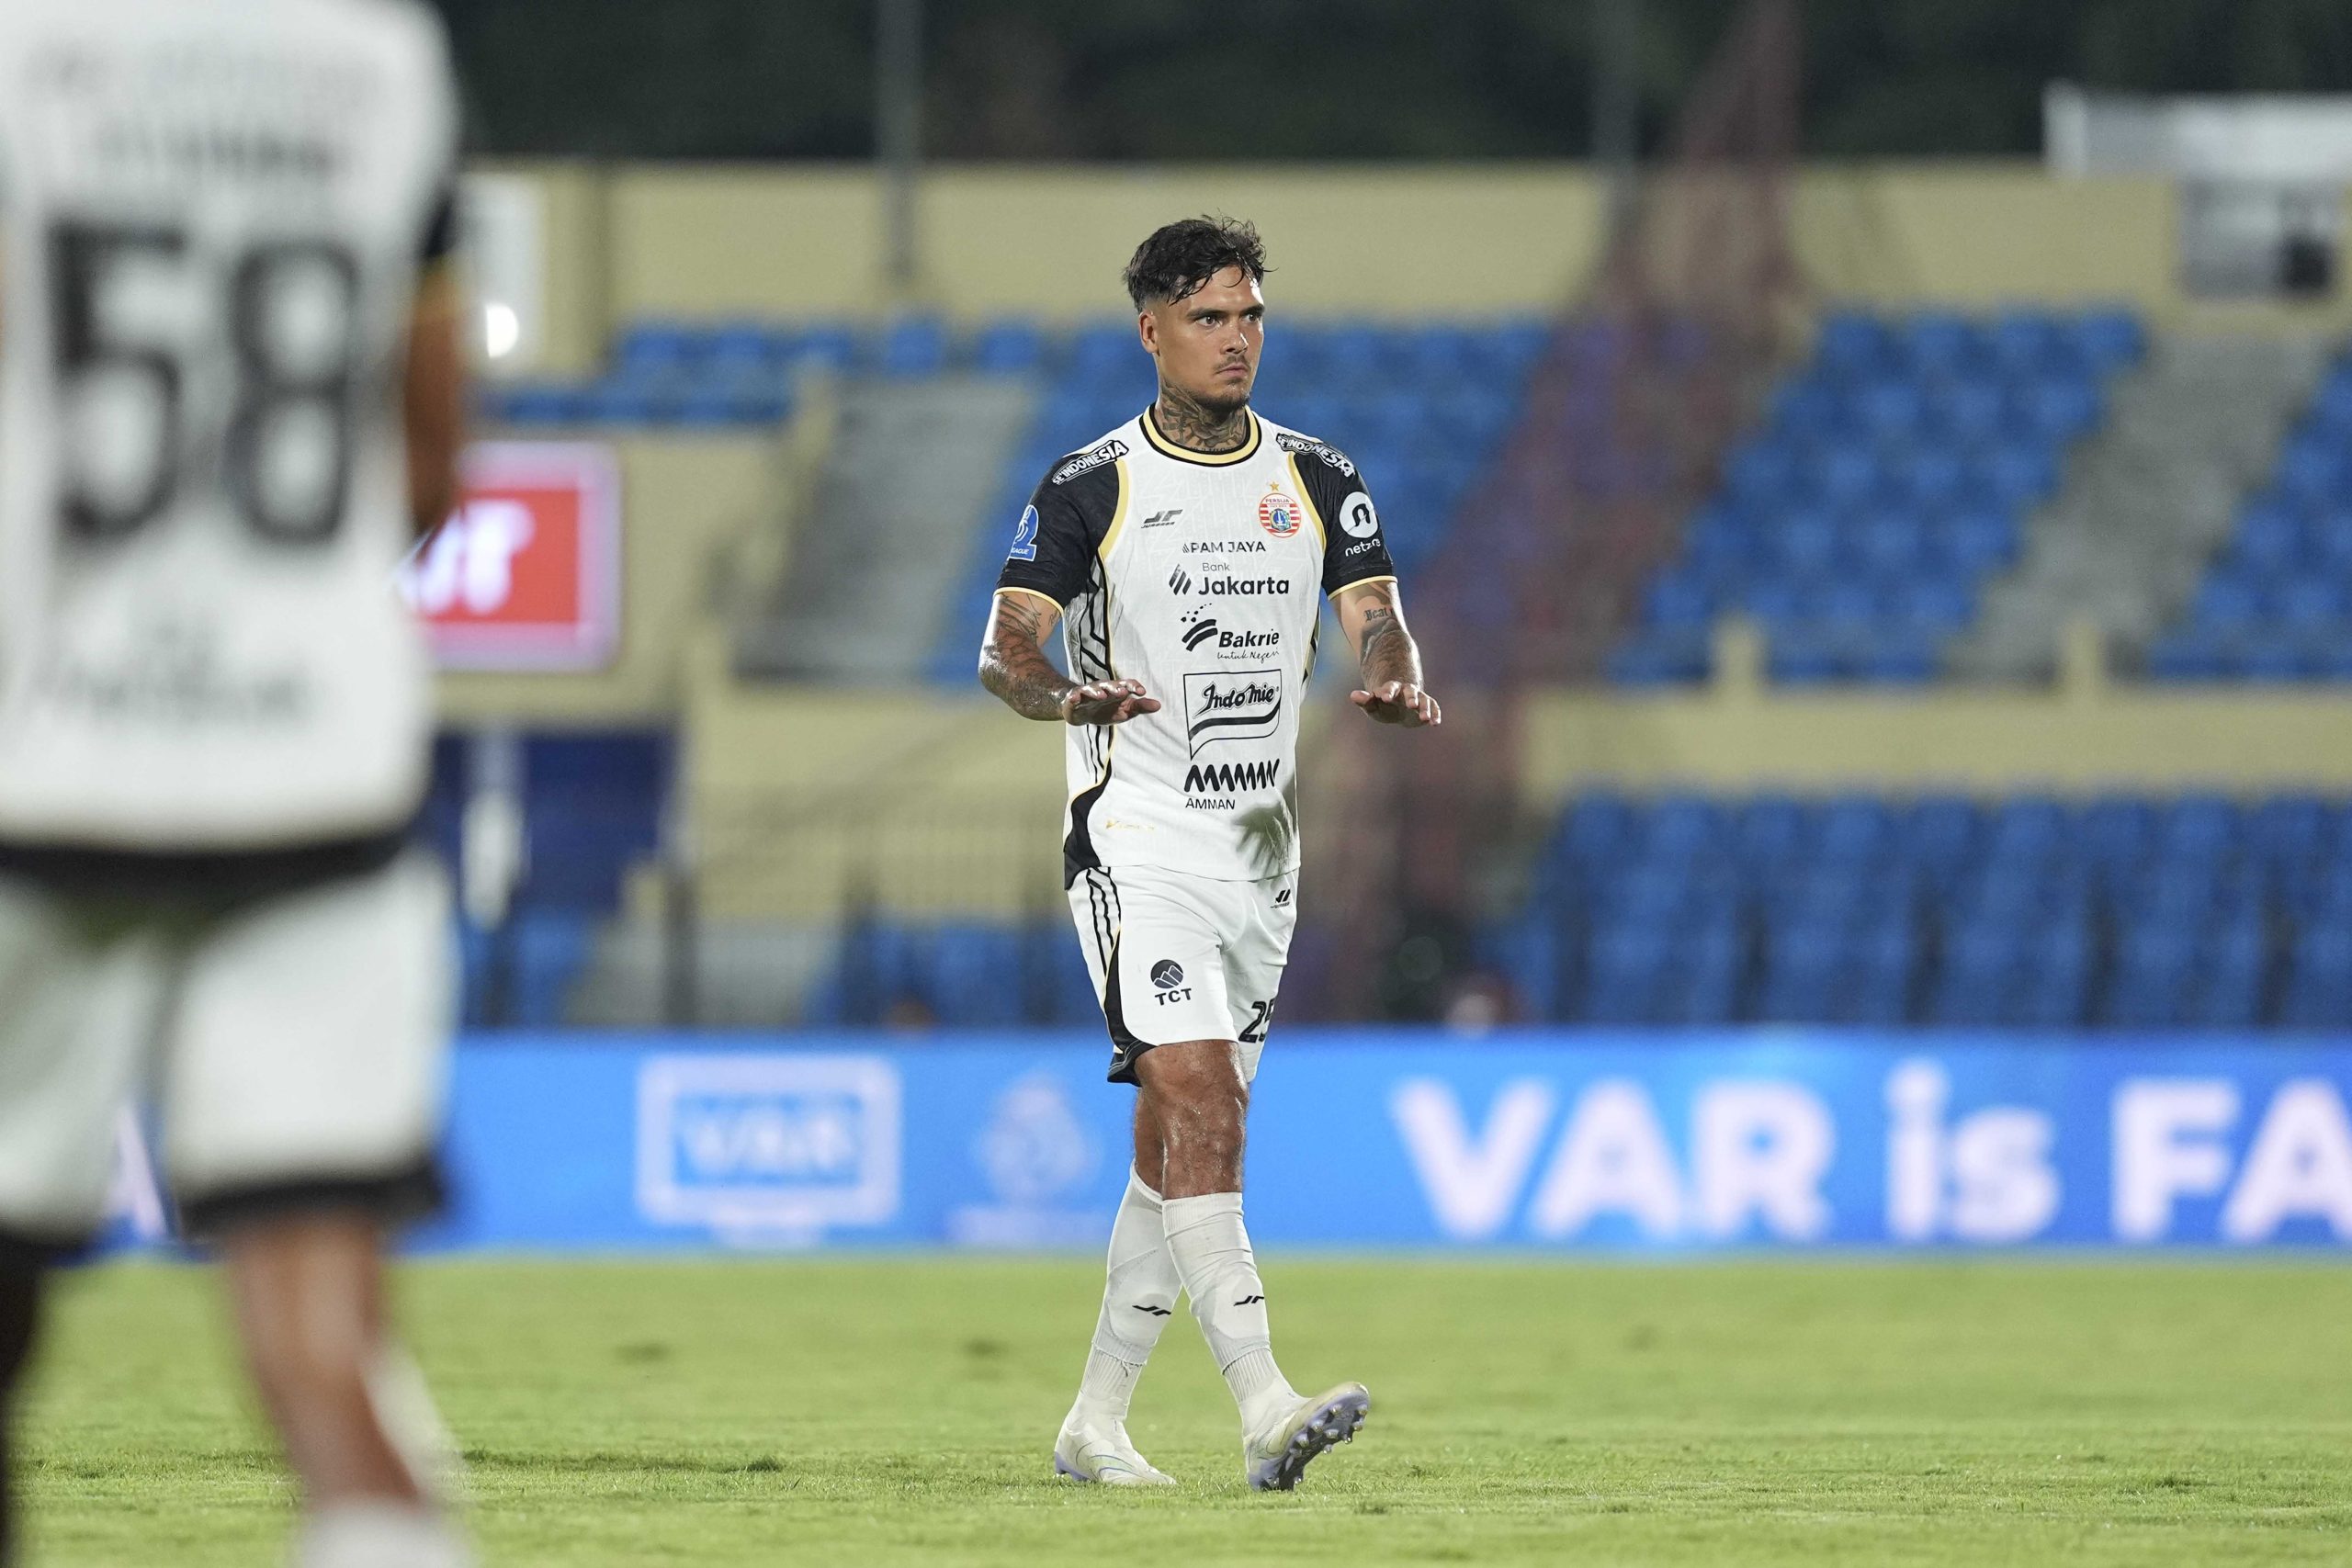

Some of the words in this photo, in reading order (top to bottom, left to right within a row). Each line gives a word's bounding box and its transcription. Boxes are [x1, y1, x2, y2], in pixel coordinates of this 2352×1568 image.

[46, 219, 362, 547] 58
[1191, 541, 1224, 553] PAM
[1227, 541, 1266, 553] JAYA
[1202, 562, 1231, 571] Bank
[1198, 576, 1289, 595] Jakarta
[1218, 628, 1280, 648] Bakrie
[1185, 797, 1236, 810] AMMAN
[1154, 987, 1192, 1006] TCT
[1392, 1077, 1834, 1242] VAR
[1882, 1060, 2064, 1242] is
